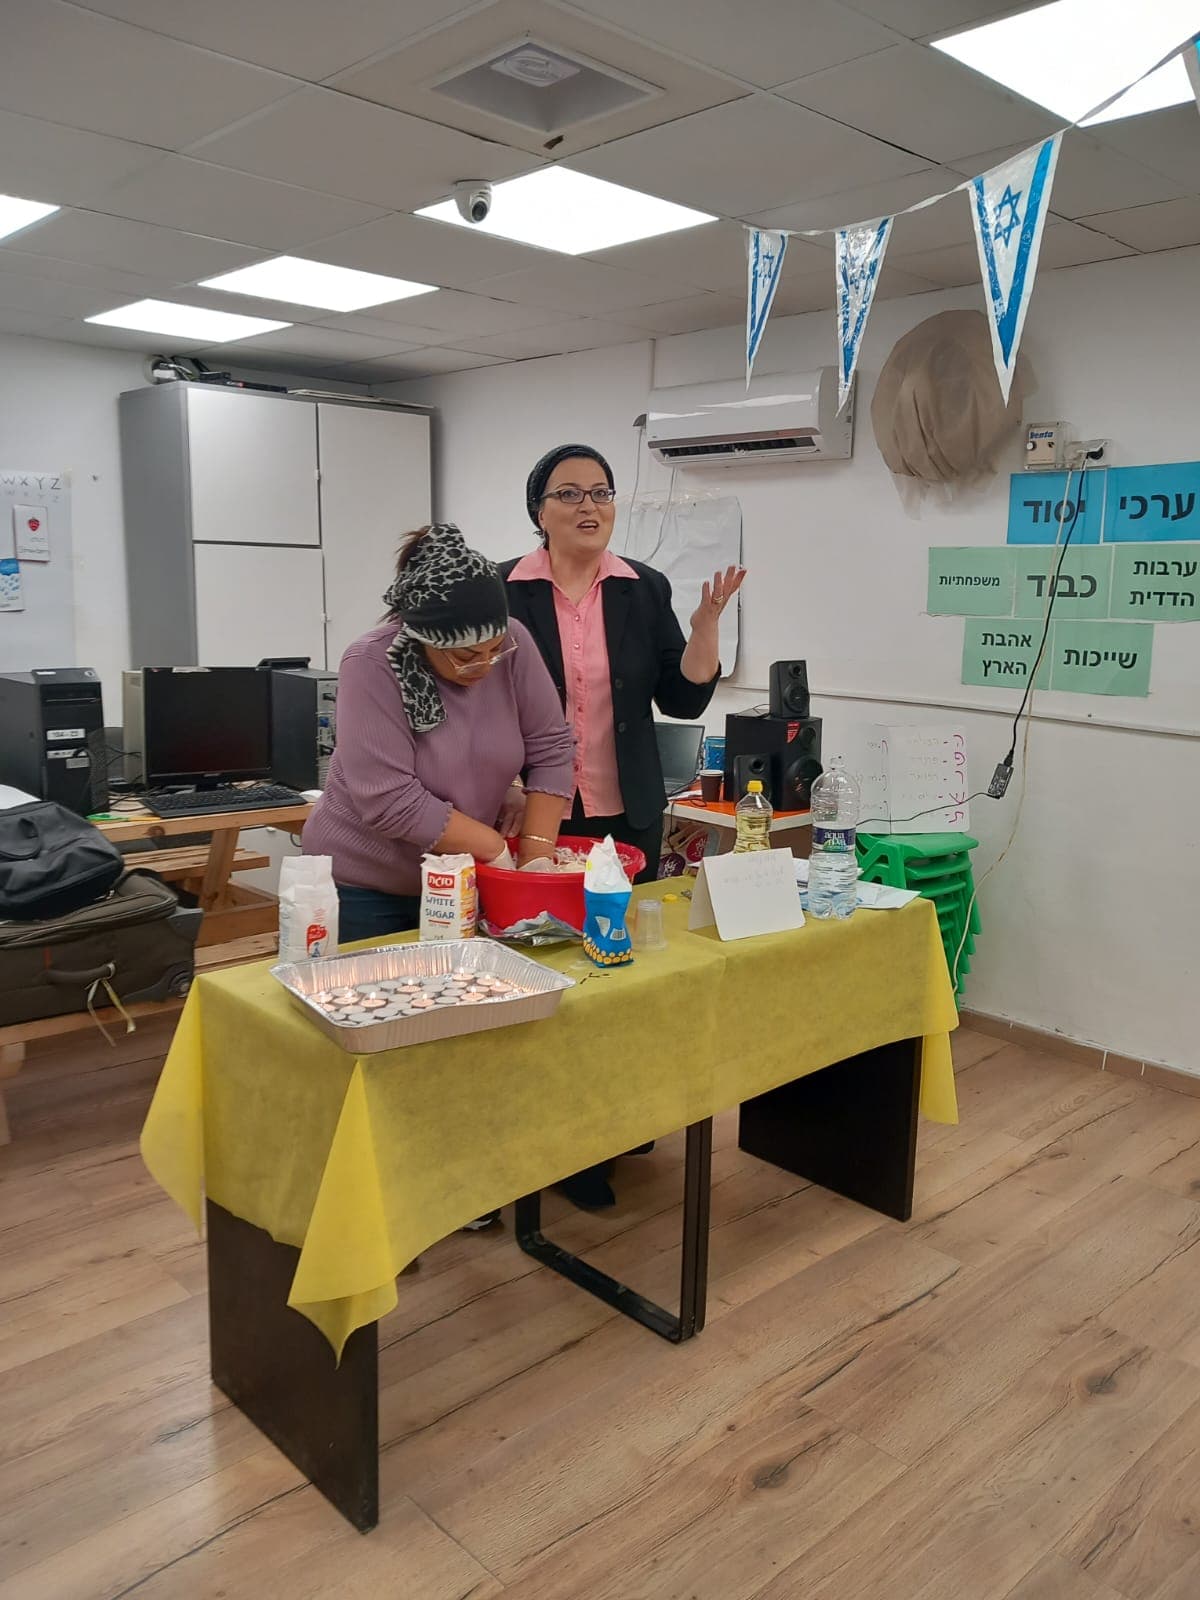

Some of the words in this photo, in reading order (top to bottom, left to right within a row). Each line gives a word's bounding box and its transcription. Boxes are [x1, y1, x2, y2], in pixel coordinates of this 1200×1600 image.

[34, 477, 45, 490] Y
[51, 478, 62, 490] Z
[1024, 500, 1086, 523] יסוד
[1119, 492, 1196, 521] ערכי
[1133, 561, 1198, 577] ערבות
[939, 575, 1000, 586] משפחתיות
[1027, 575, 1097, 598] כבוד
[1129, 591, 1195, 606] הדדית
[981, 632, 1032, 647] אהבת
[1063, 649, 1137, 669] שייכות
[982, 660, 1027, 677] הארץ
[425, 896, 455, 906] WHITE
[425, 908, 455, 920] SUGAR
